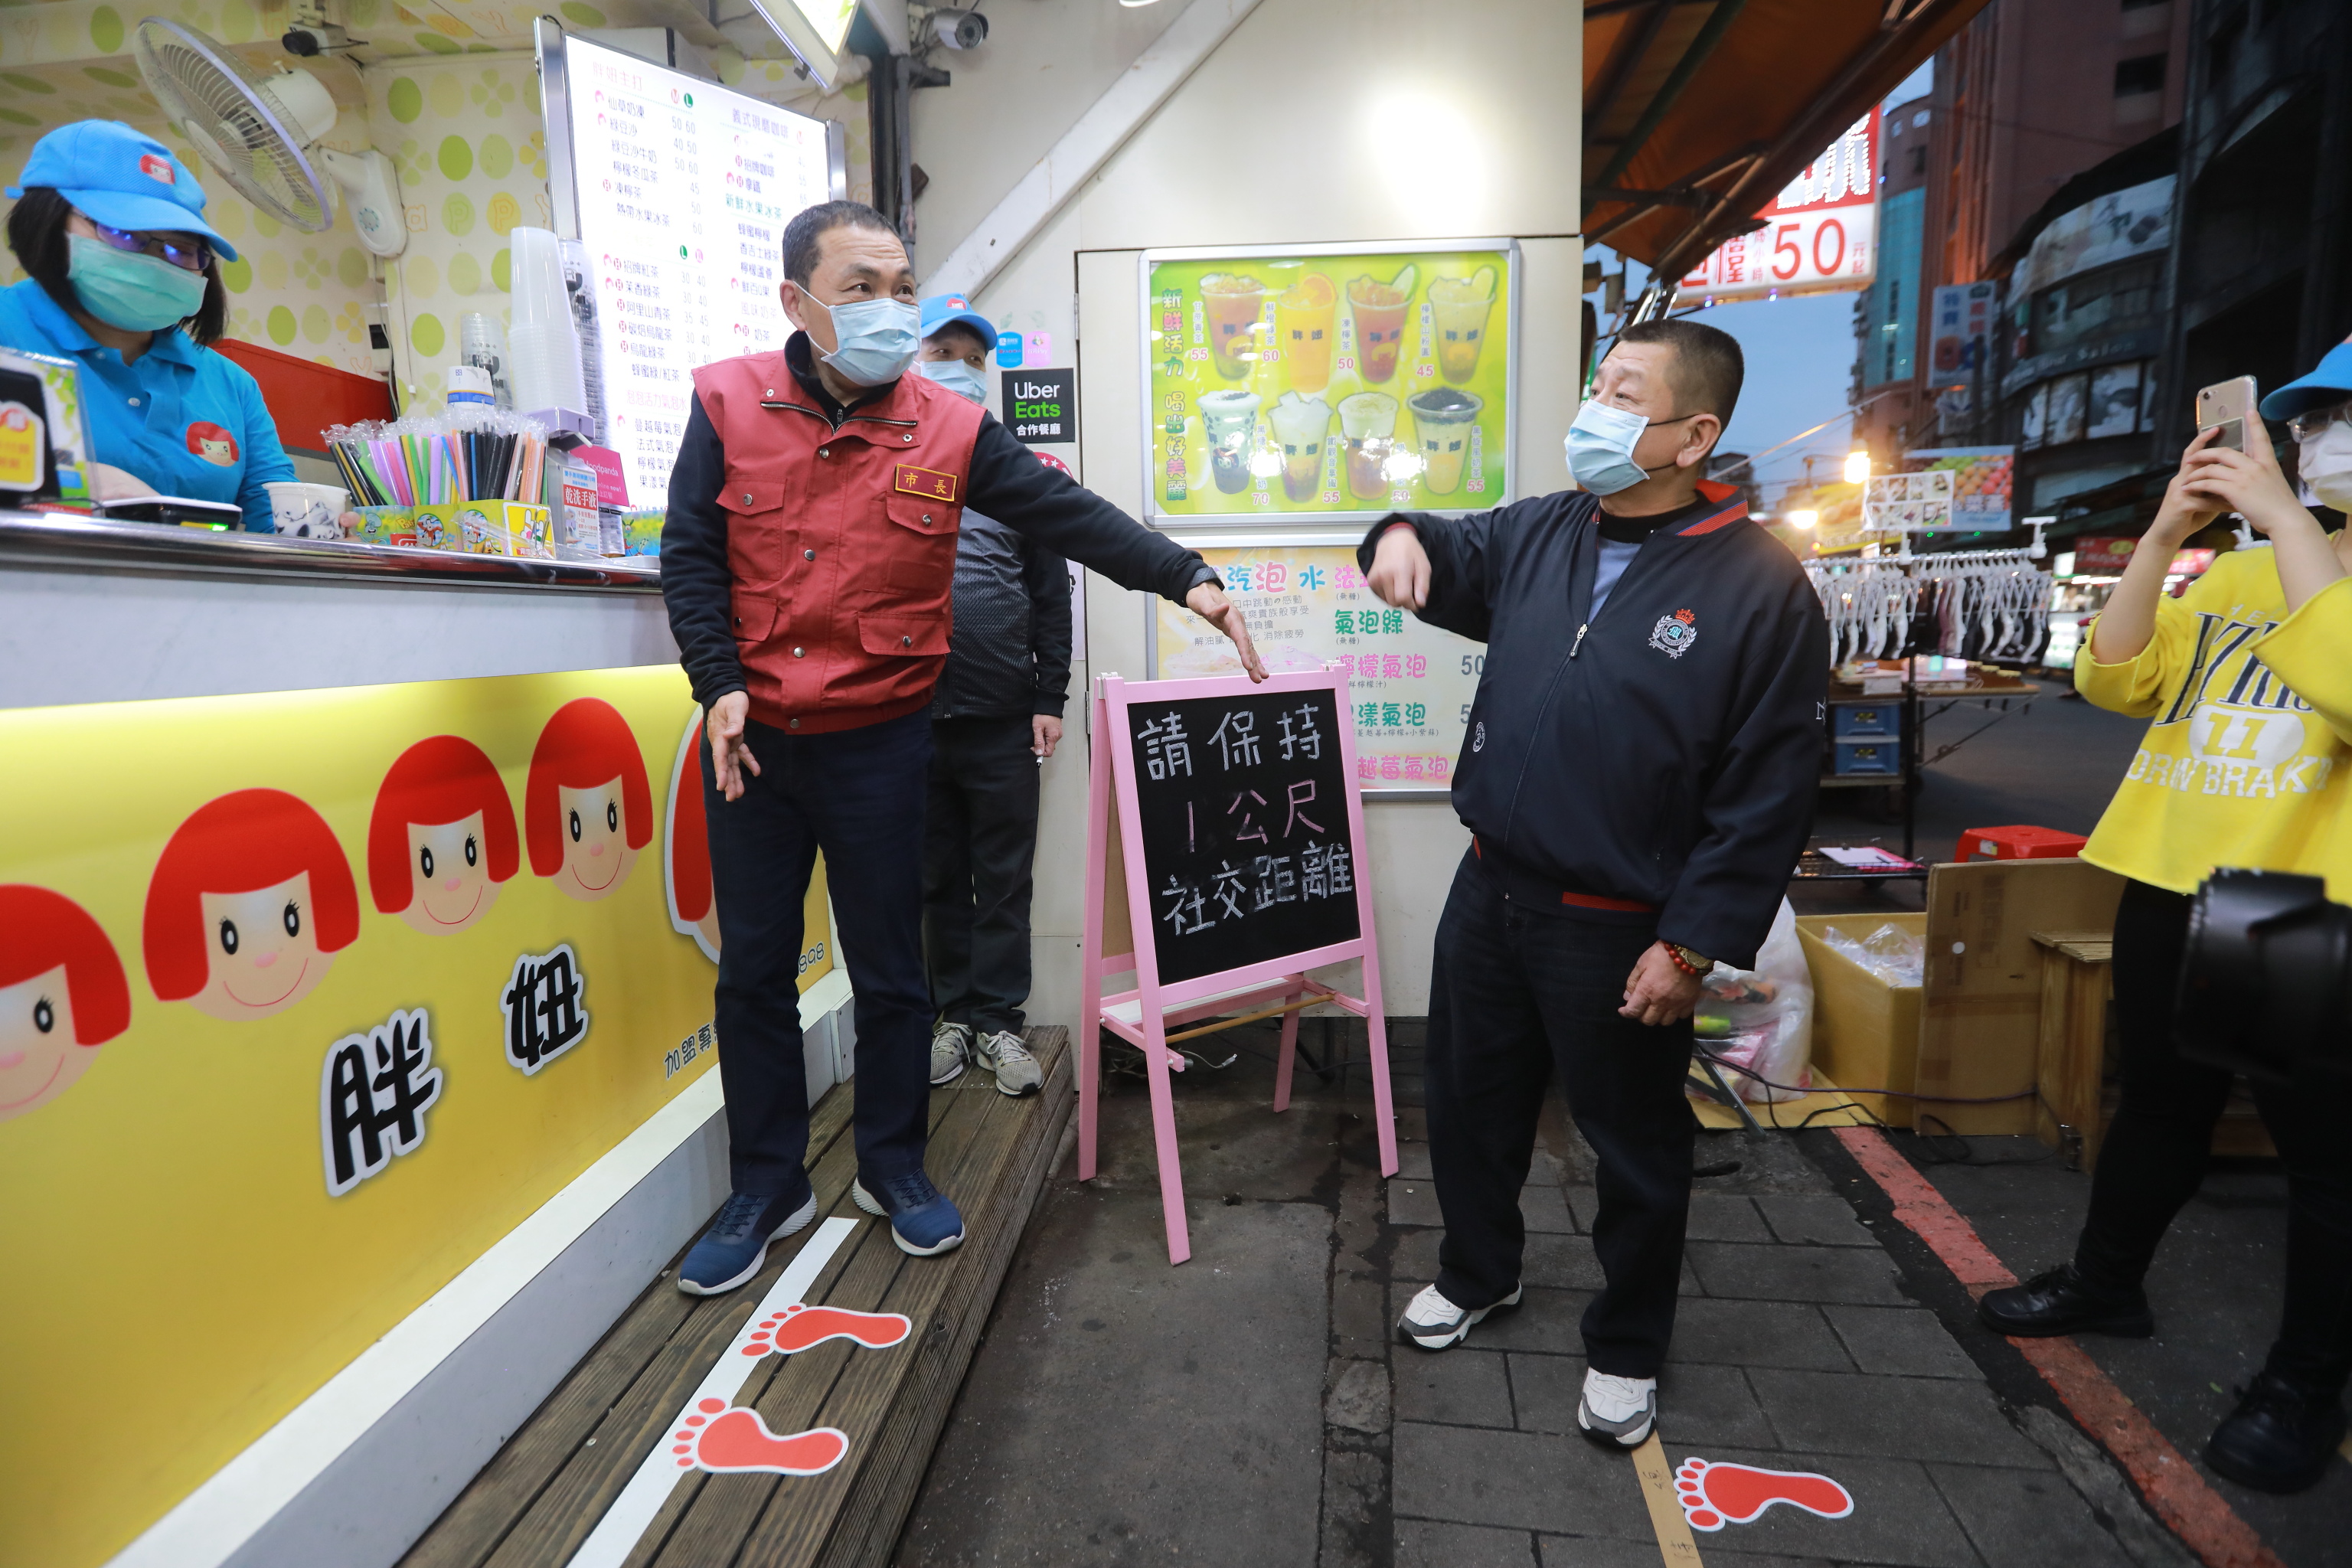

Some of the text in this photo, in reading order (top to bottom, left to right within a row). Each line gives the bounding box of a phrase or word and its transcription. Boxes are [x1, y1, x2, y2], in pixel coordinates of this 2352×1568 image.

[610, 118, 637, 137] 綠豆沙
[612, 139, 657, 164] 綠豆沙牛奶
[726, 193, 782, 220] 新鮮水果冰茶
[1772, 218, 1845, 281] 50
[741, 301, 777, 319] 風味奶茶
[754, 328, 770, 342] 奶茶
[1191, 348, 1208, 361] 55
[1263, 350, 1279, 362] 60
[1338, 358, 1354, 369] 50
[1416, 364, 1434, 377] 45
[1014, 382, 1060, 399] Uber
[1162, 288, 1187, 501] 新鮮活力 喝出好美麗
[1015, 401, 1060, 418] Eats
[1016, 423, 1060, 436] 合作餐廳
[639, 475, 670, 490] 果漾氣
[904, 472, 947, 494] 市長
[1468, 480, 1485, 492] 55
[565, 487, 596, 508] 乾洗手液
[1253, 493, 1269, 505] 70
[1323, 491, 1340, 503] 55
[1334, 609, 1403, 635] 氣泡綠
[1263, 629, 1305, 641] 消除疲勞
[1352, 702, 1426, 727] 漾氣泡
[1137, 703, 1321, 780] 請保持
[1161, 840, 1354, 936] 社交距離
